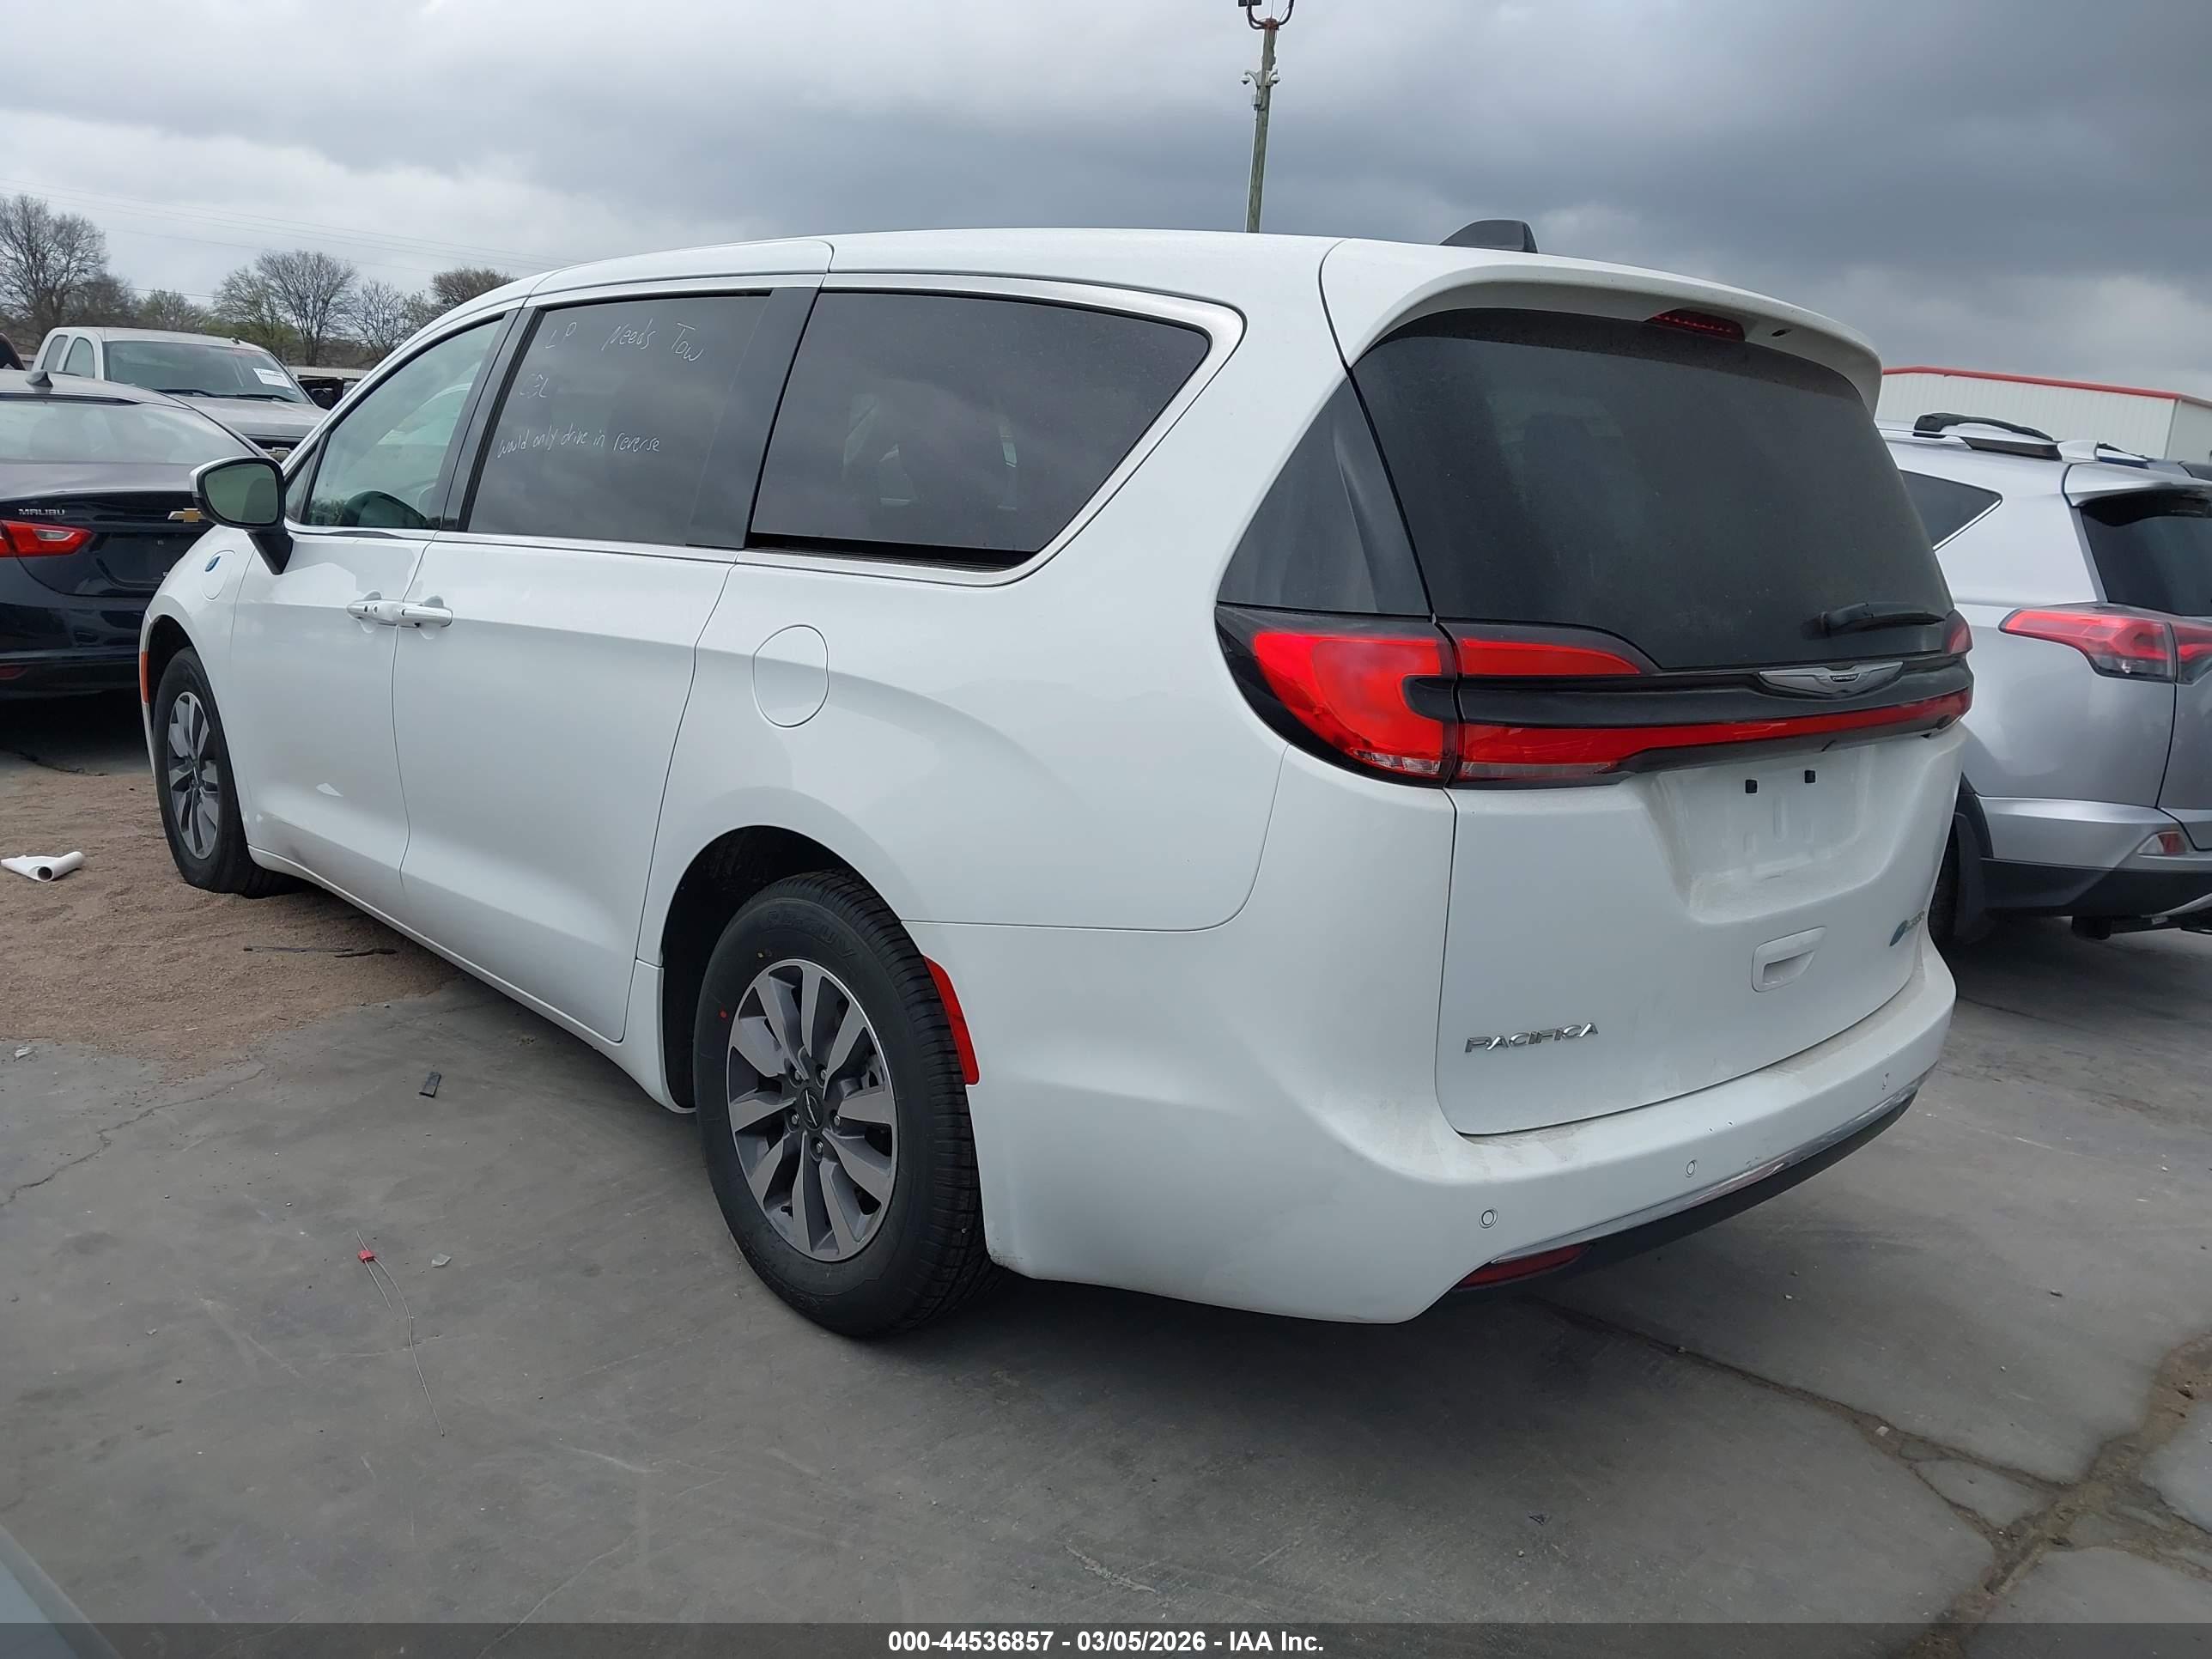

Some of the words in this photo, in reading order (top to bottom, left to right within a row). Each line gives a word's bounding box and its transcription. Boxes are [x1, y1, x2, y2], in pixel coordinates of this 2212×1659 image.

[672, 322, 704, 362] Tow
[532, 426, 558, 451] only
[560, 422, 588, 446] drive
[592, 429, 605, 447] in
[613, 432, 660, 453] reverse
[1464, 1022, 1599, 1054] PACIFICA
